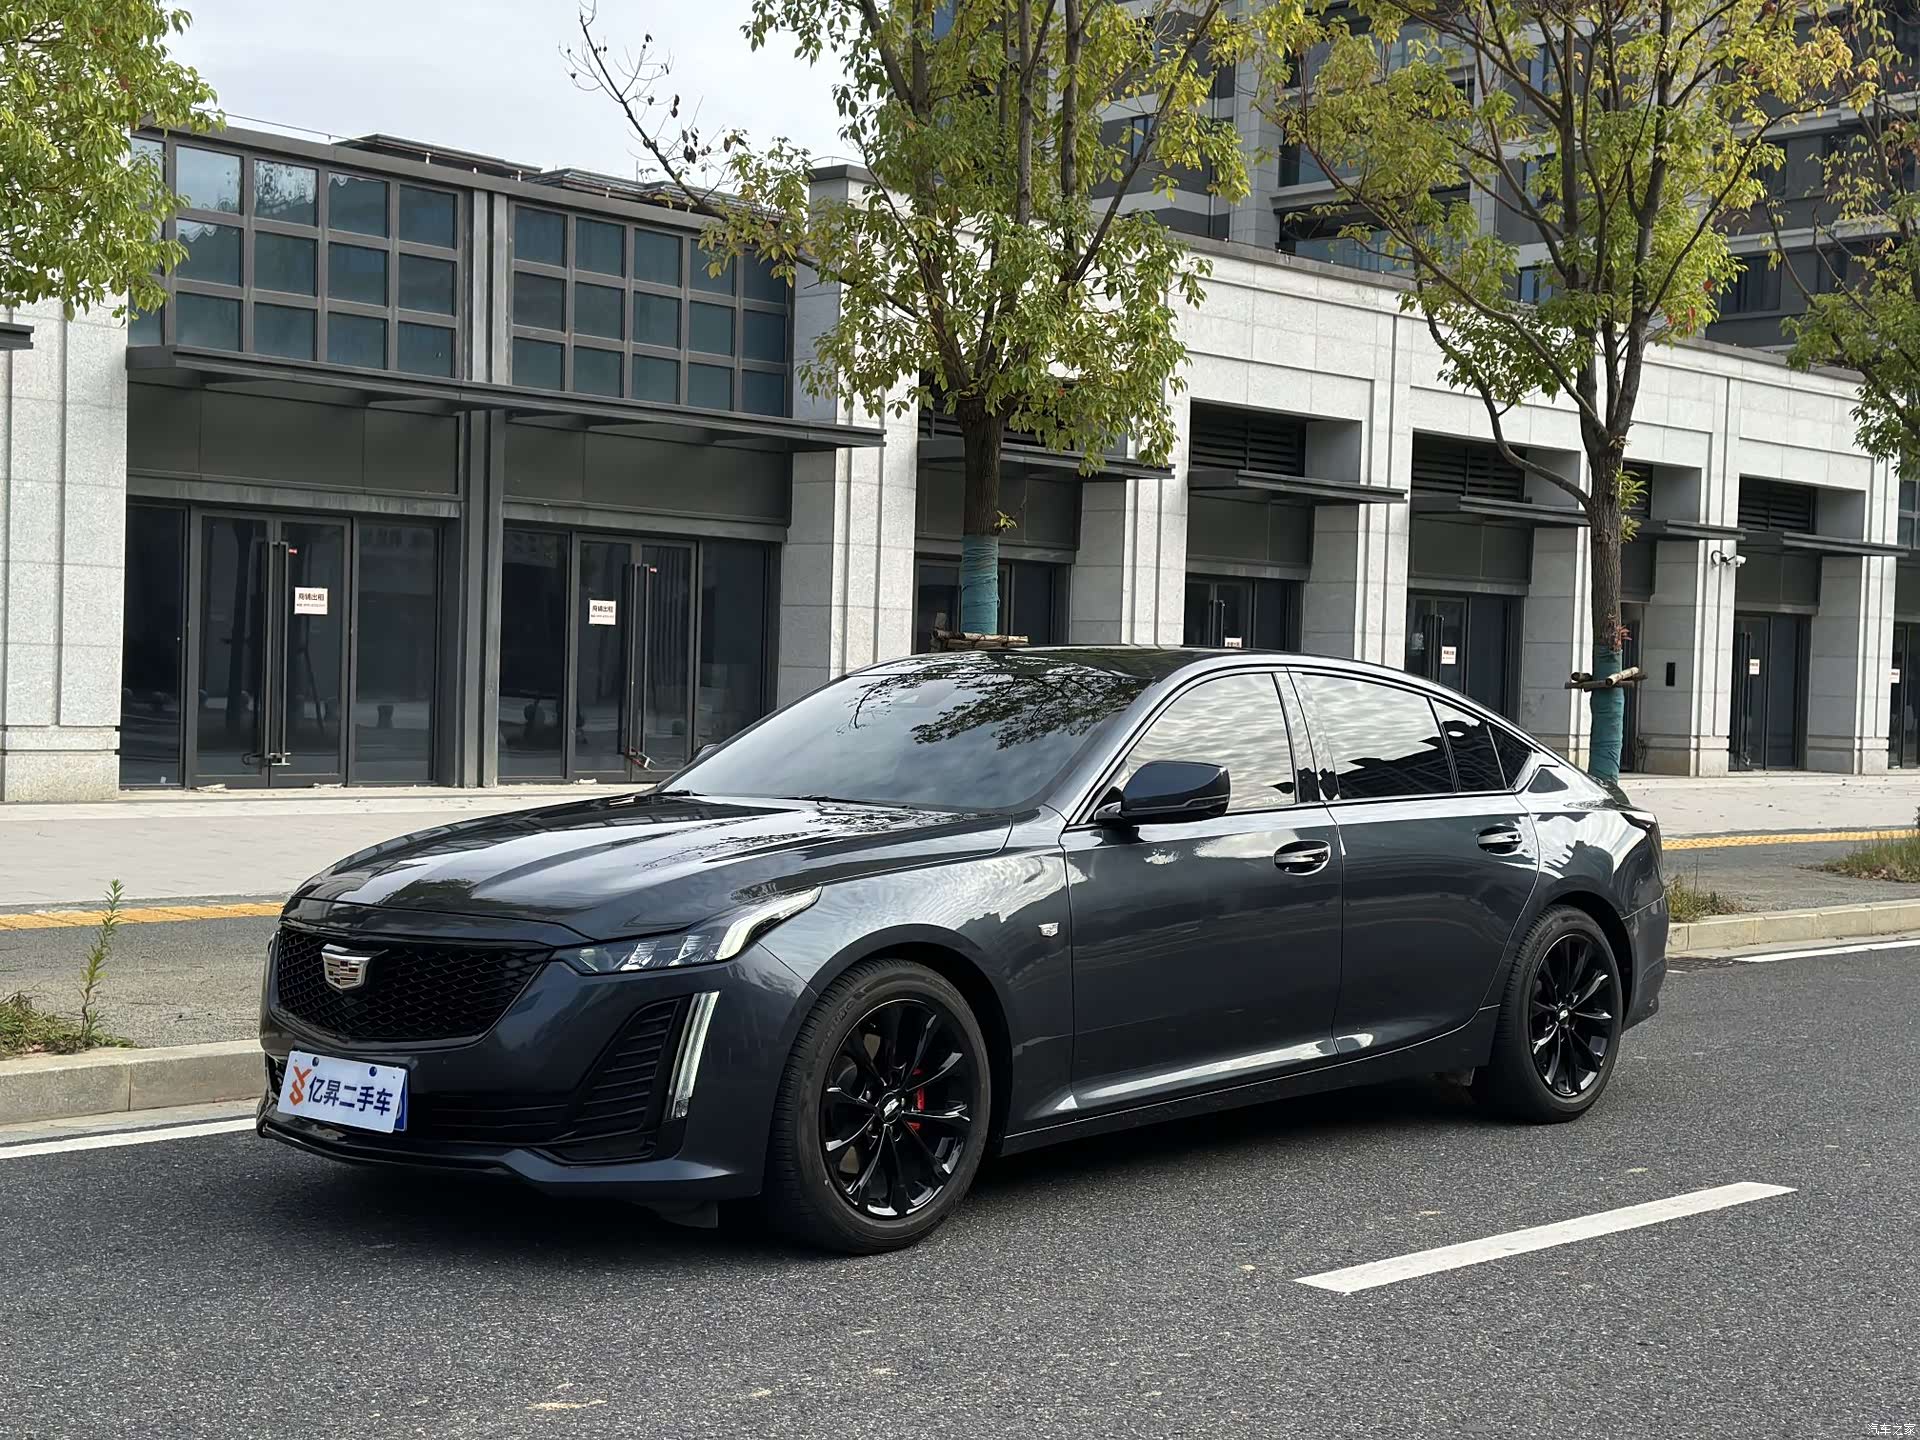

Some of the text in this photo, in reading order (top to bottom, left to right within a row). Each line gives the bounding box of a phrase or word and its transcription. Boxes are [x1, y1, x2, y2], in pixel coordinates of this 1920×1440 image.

[308, 1076, 393, 1116] 亿昇二手车
